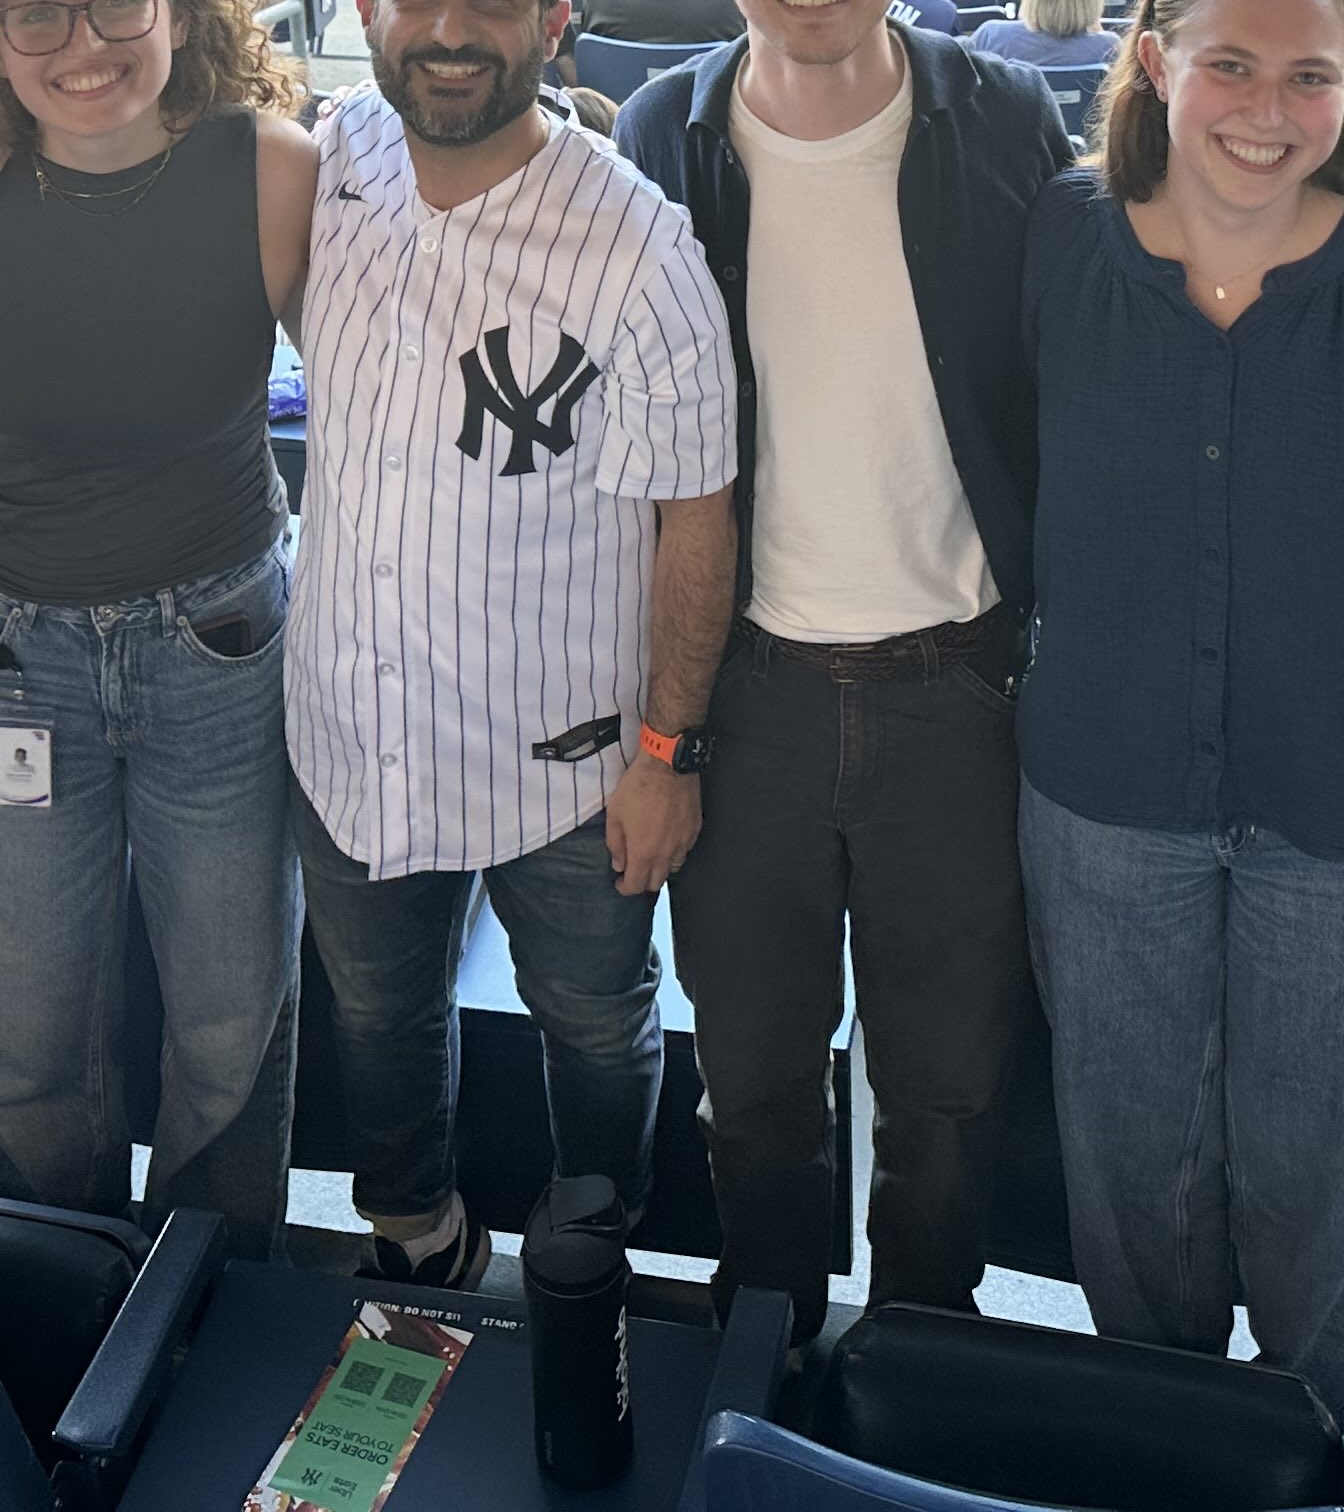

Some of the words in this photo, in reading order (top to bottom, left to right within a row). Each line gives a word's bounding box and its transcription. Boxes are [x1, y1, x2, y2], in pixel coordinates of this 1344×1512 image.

[454, 325, 602, 477] NY
[404, 1306, 419, 1315] DO
[421, 1309, 444, 1318] NOT
[311, 1420, 343, 1437] SEAT
[305, 1431, 341, 1451] EATS
[343, 1429, 376, 1448] YOUR
[376, 1440, 394, 1454] TO
[340, 1445, 389, 1465] ORDER
